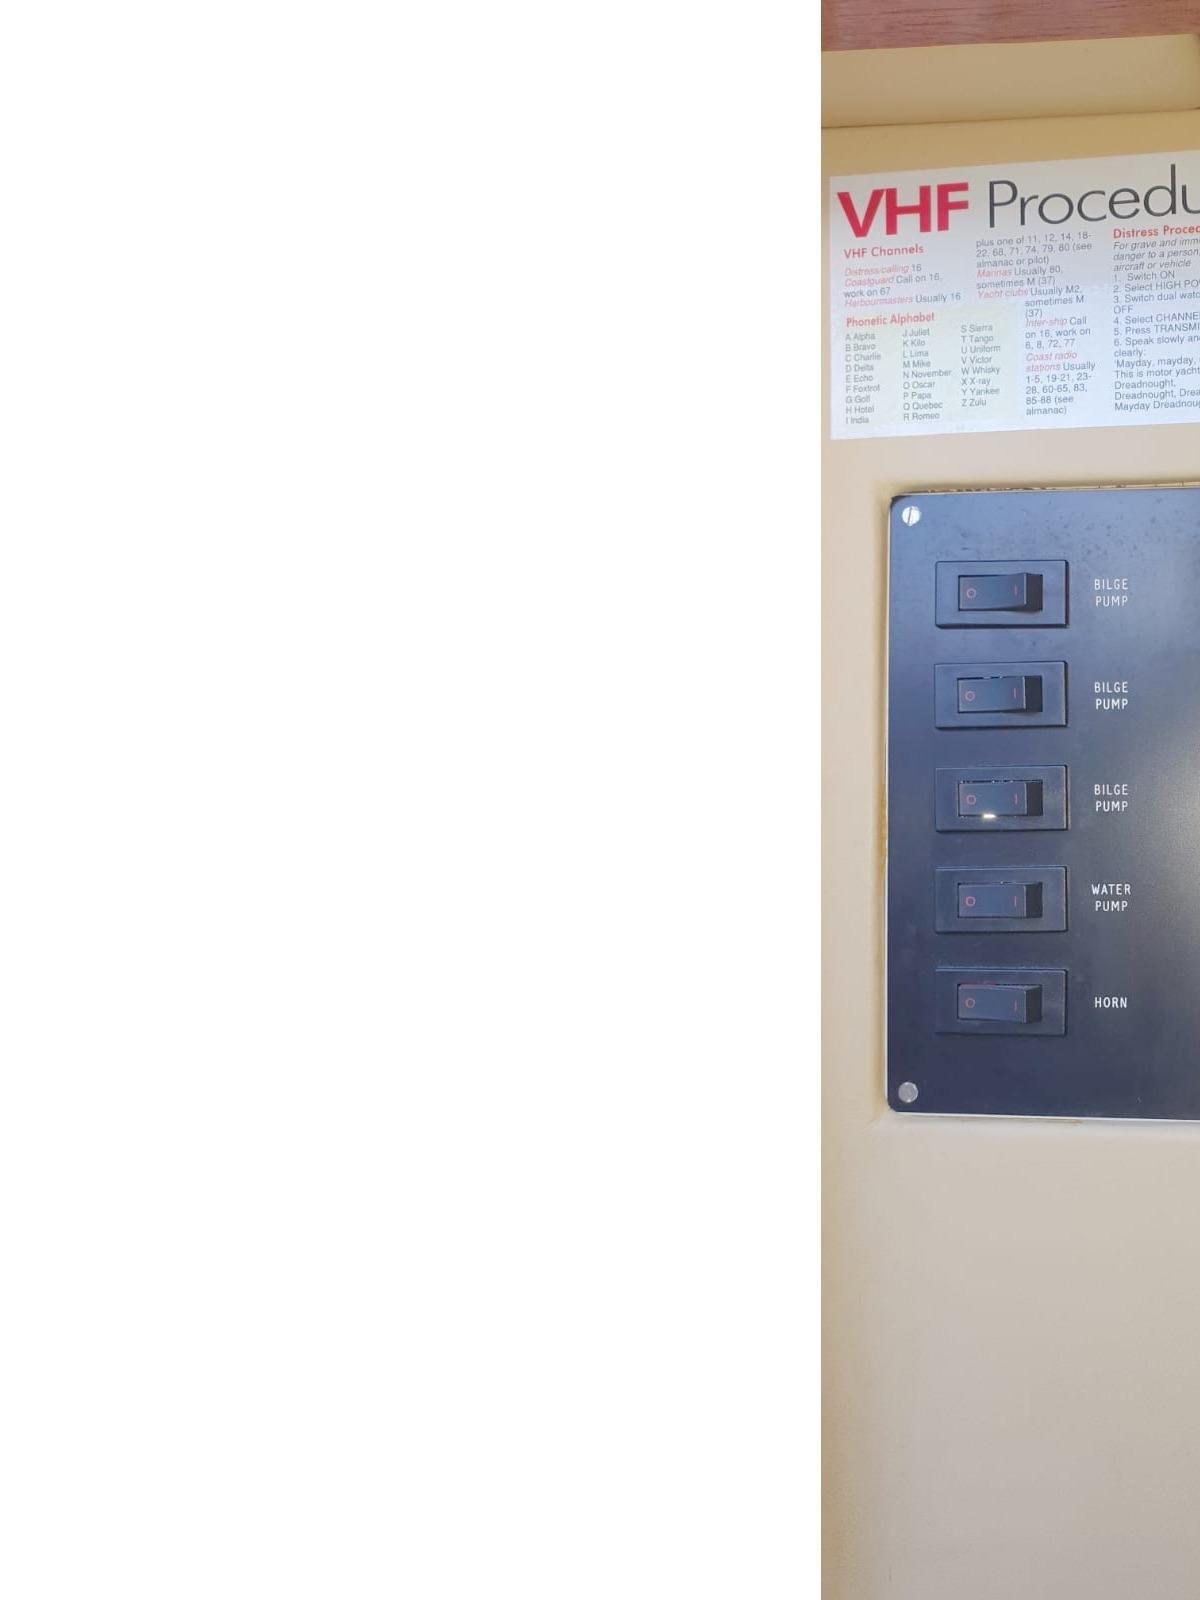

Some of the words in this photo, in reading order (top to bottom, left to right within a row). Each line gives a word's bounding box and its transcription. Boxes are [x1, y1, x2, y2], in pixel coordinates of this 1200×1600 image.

[836, 181, 970, 239] VHF
[1113, 227, 1159, 239] Distress
[1130, 240, 1157, 251] grave
[1159, 238, 1177, 247] and
[844, 247, 867, 259] VHF
[871, 243, 925, 257] Channels
[1113, 251, 1145, 261] danger
[976, 258, 1014, 269] almanac
[1113, 261, 1145, 272] aircraft
[1159, 258, 1192, 269] vehicle
[1014, 266, 1047, 276] Usually
[1127, 271, 1157, 281] Switch
[1160, 270, 1175, 280] ON
[976, 277, 1025, 289] sometimes
[1124, 282, 1153, 293] Select
[1155, 279, 1181, 291] HIGH
[844, 289, 866, 299] work
[1030, 286, 1063, 297] Usually
[1124, 292, 1155, 303] Switch
[1157, 291, 1177, 302] dual
[1024, 296, 1073, 307] sometimes
[1113, 304, 1133, 314] OFF
[846, 316, 887, 328] Phonetic
[890, 312, 935, 326] Alphabet
[1124, 314, 1153, 325] Select
[909, 328, 930, 337] Juliet
[1055, 328, 1077, 337] work
[1125, 325, 1151, 335] Press
[853, 332, 876, 342] Alpha
[968, 335, 994, 344] Tango
[1124, 336, 1154, 347] Speak
[1157, 333, 1184, 345] slowly
[969, 355, 992, 364] Victor
[1063, 361, 1096, 371] Usually
[911, 369, 952, 379] November
[1114, 369, 1133, 379] This
[1146, 367, 1173, 377] motor
[1175, 366, 1200, 378] yacht
[911, 380, 936, 389] Oscar
[969, 397, 987, 407] Zulu
[1114, 401, 1150, 412] Mayday
[854, 405, 874, 414] Hotel
[1094, 578, 1129, 591] BILGE
[1095, 595, 1128, 607] PUMP
[1094, 681, 1129, 694] BILGE
[1095, 698, 1129, 710] PUMP
[1094, 783, 1129, 796] BILGE
[1095, 800, 1128, 812] PUMP
[1091, 883, 1131, 896] WATER
[1095, 900, 1128, 912] PUMP
[1094, 996, 1128, 1009] HORN
